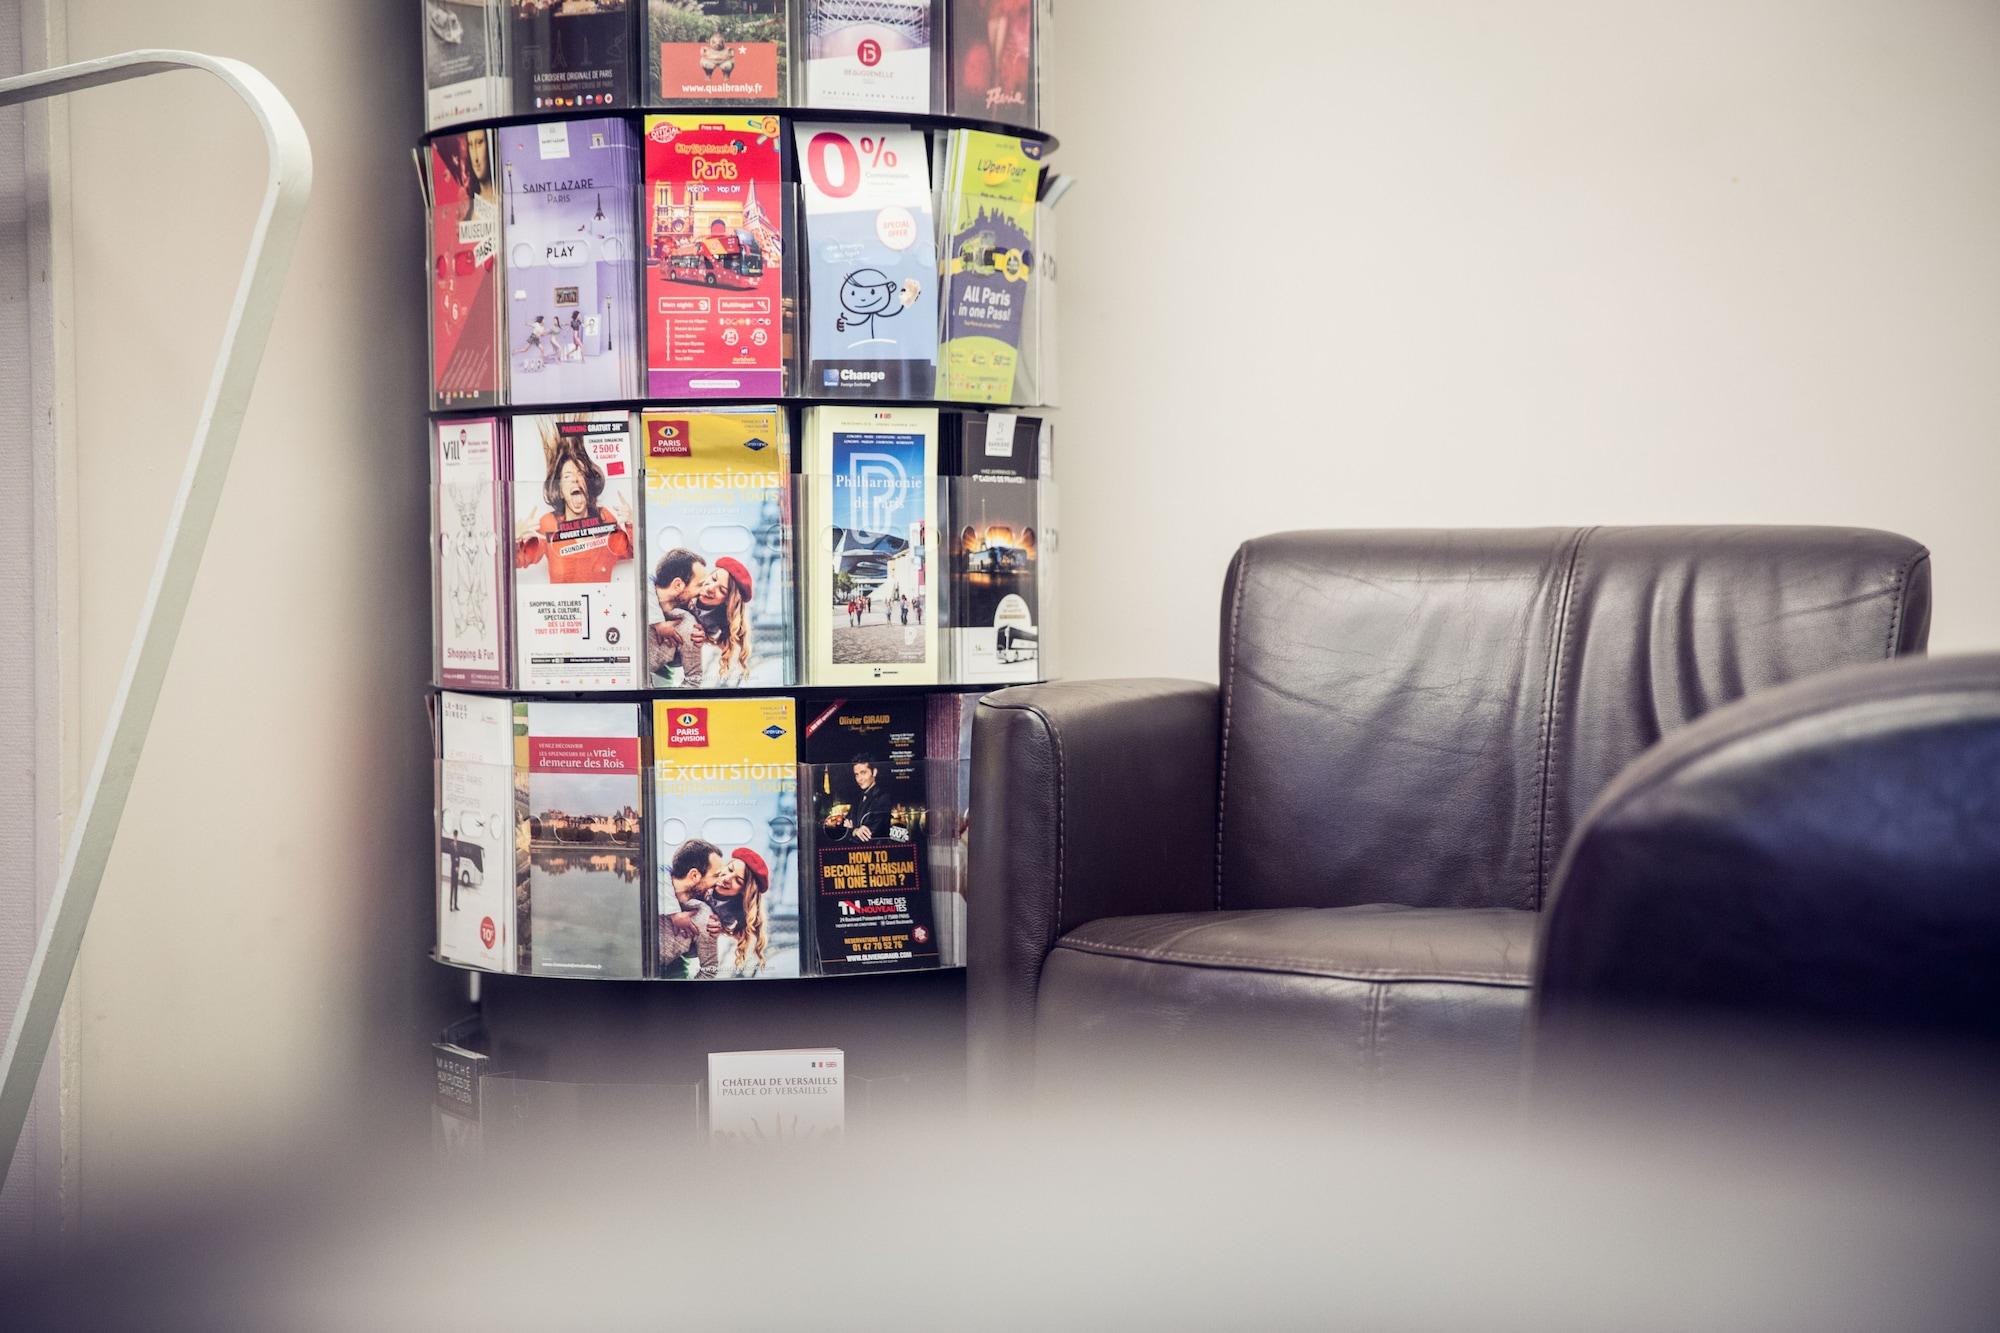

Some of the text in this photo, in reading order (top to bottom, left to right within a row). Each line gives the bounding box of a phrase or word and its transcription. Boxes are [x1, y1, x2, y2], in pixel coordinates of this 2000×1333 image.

[534, 74, 541, 83] LA
[567, 71, 592, 81] ORIGINALE
[592, 70, 599, 79] DE
[600, 69, 613, 78] PARIS
[682, 82, 763, 94] www.quaibranly.fr
[692, 157, 738, 180] Paris
[523, 179, 593, 193] SAINT LAZARE
[884, 220, 909, 229] SPECIAL
[547, 246, 574, 258] PLAY
[963, 286, 1011, 306] All Paris
[958, 303, 1011, 321] in one Pass!
[840, 369, 885, 382] Change
[588, 424, 611, 432] GRATUIT
[646, 467, 779, 490] Excursions
[560, 531, 580, 539] OUVERT
[447, 648, 476, 662] Shopping
[484, 649, 495, 660] Fun
[839, 715, 890, 725] Olivier GIRAUD
[593, 748, 616, 758] vraie
[540, 757, 624, 768] demeure des Rois
[662, 758, 797, 780] Excursions
[889, 826, 909, 842] 100%
[848, 850, 888, 864] HOW TO
[824, 861, 914, 878] BECOME PARISIAN
[835, 874, 905, 889] IN ONE HOUR ?
[852, 941, 903, 951] 01 47 70 52 76
[723, 1077, 838, 1087] CHÂTEAU DE VERSAILLES
[722, 1086, 828, 1096] PALACE OF VERSAILLES
